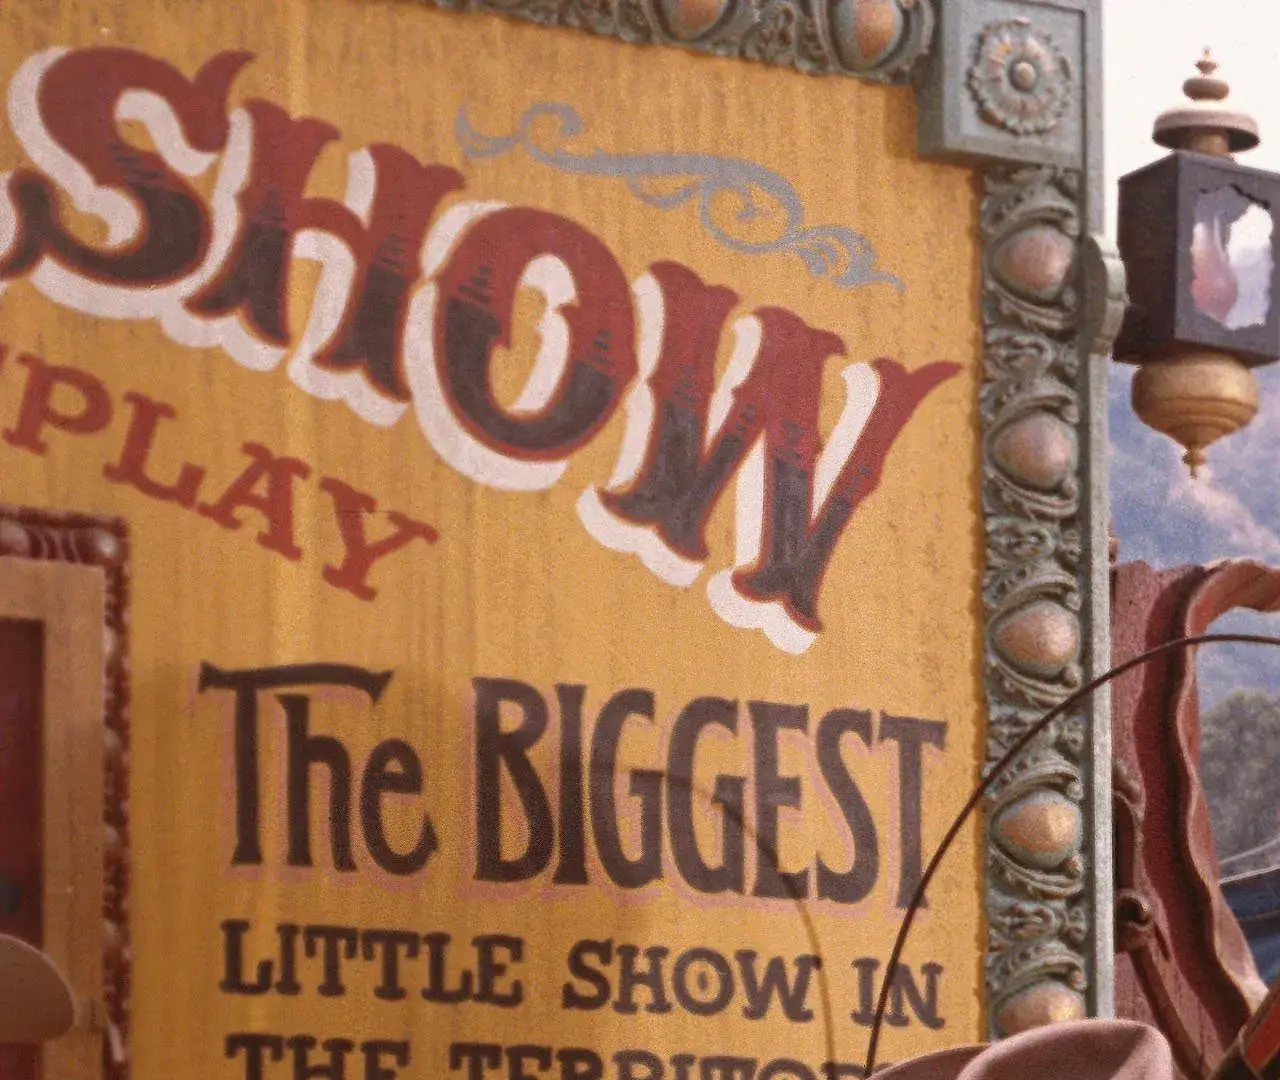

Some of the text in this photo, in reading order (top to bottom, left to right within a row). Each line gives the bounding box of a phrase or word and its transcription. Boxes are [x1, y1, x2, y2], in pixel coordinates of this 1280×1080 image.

[0, 47, 963, 653] SHOW
[0, 344, 439, 601] PLAY
[200, 662, 949, 910] The BIGGEST
[219, 919, 947, 1029] LITTLE SHOW IN
